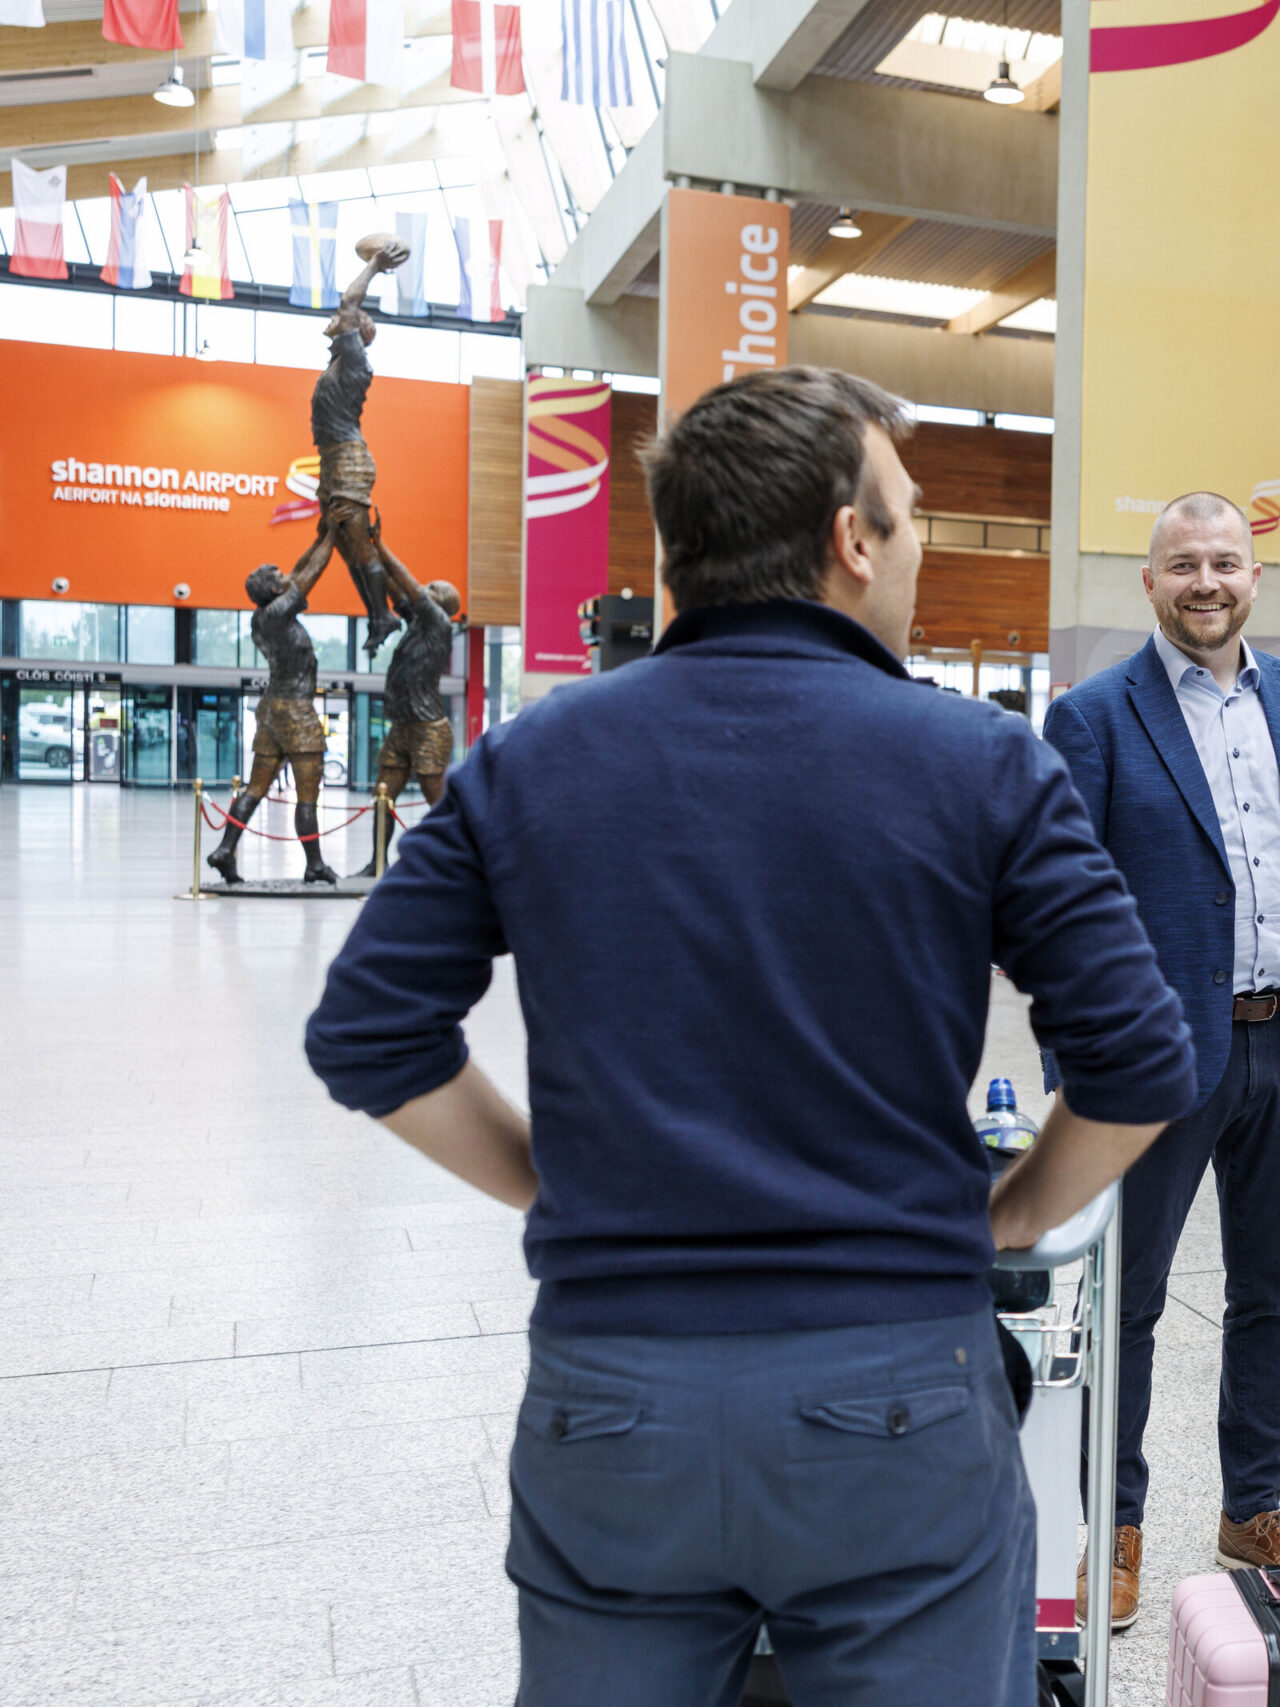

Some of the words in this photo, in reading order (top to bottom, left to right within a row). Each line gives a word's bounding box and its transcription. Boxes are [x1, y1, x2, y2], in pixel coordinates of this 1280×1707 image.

[52, 457, 179, 490] shannon
[183, 470, 279, 497] AIRPORT
[54, 486, 119, 503] AERFORT
[121, 490, 142, 506] NA
[1115, 496, 1167, 514] shann
